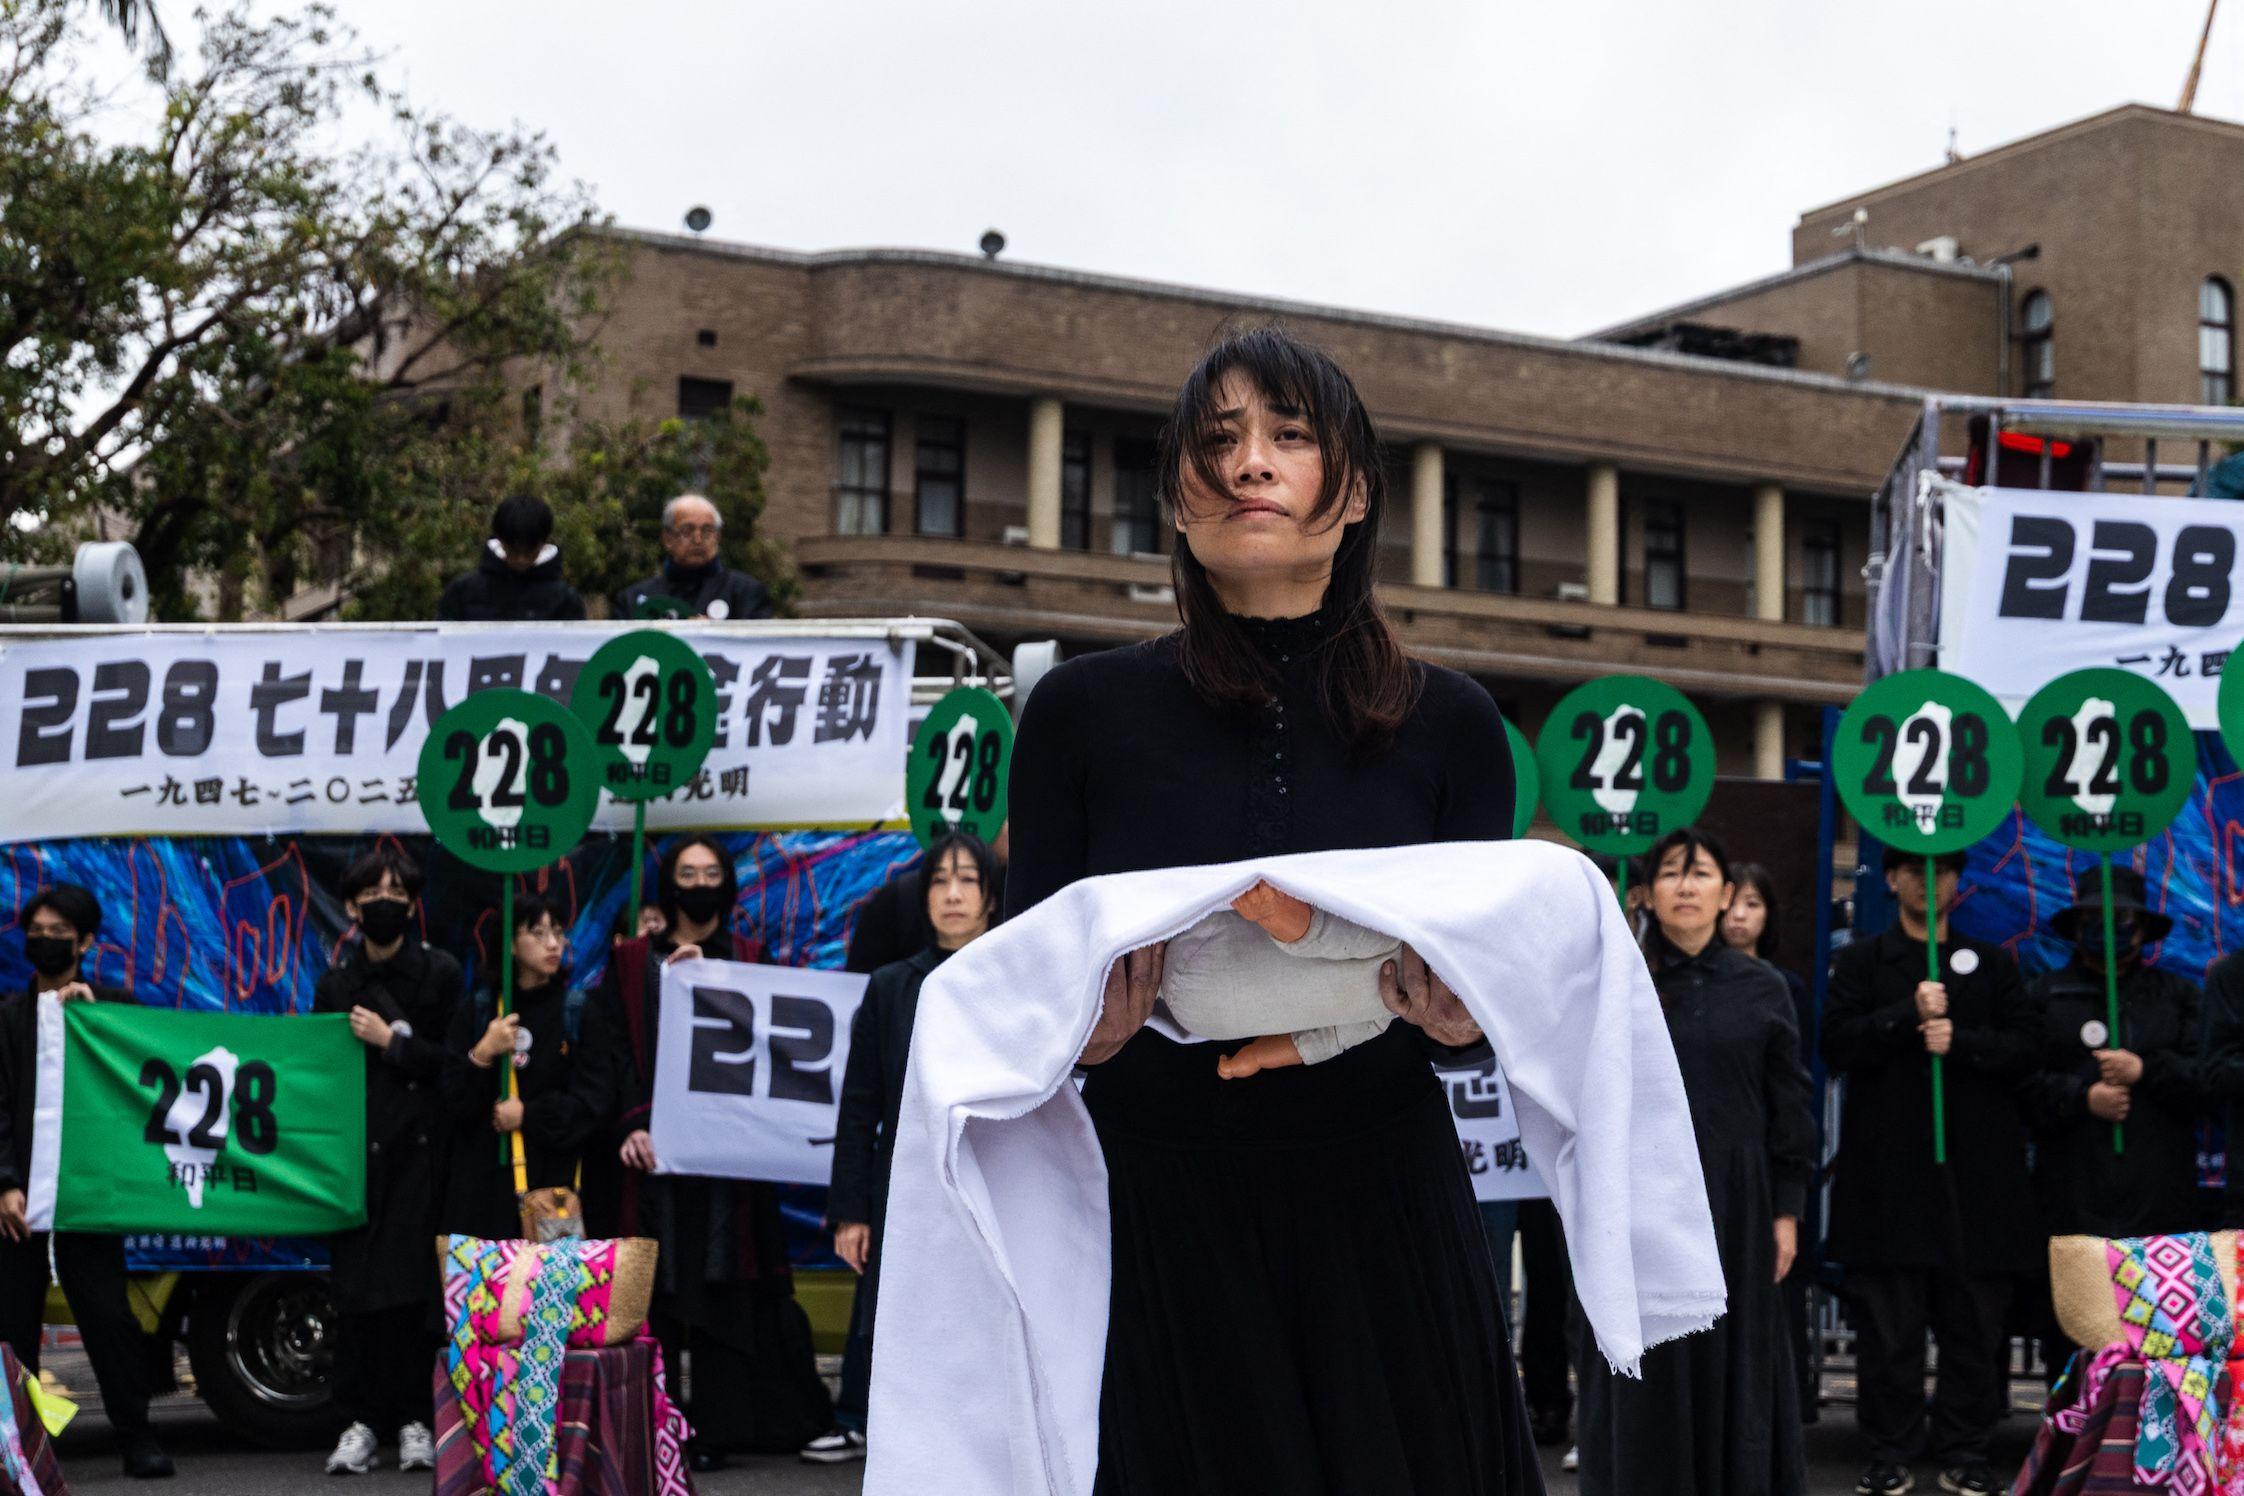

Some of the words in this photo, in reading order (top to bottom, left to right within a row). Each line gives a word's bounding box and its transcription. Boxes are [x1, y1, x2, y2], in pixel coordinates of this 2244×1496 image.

[1999, 514, 2236, 627] 228
[16, 658, 219, 767] 228
[597, 668, 697, 748] 228
[1570, 709, 1691, 793] 228
[444, 722, 570, 810] 228
[923, 730, 1001, 812] 228
[1861, 712, 1989, 797] 228
[2042, 709, 2169, 796] 228
[689, 986, 862, 1105] 22
[140, 1058, 278, 1156] 228
